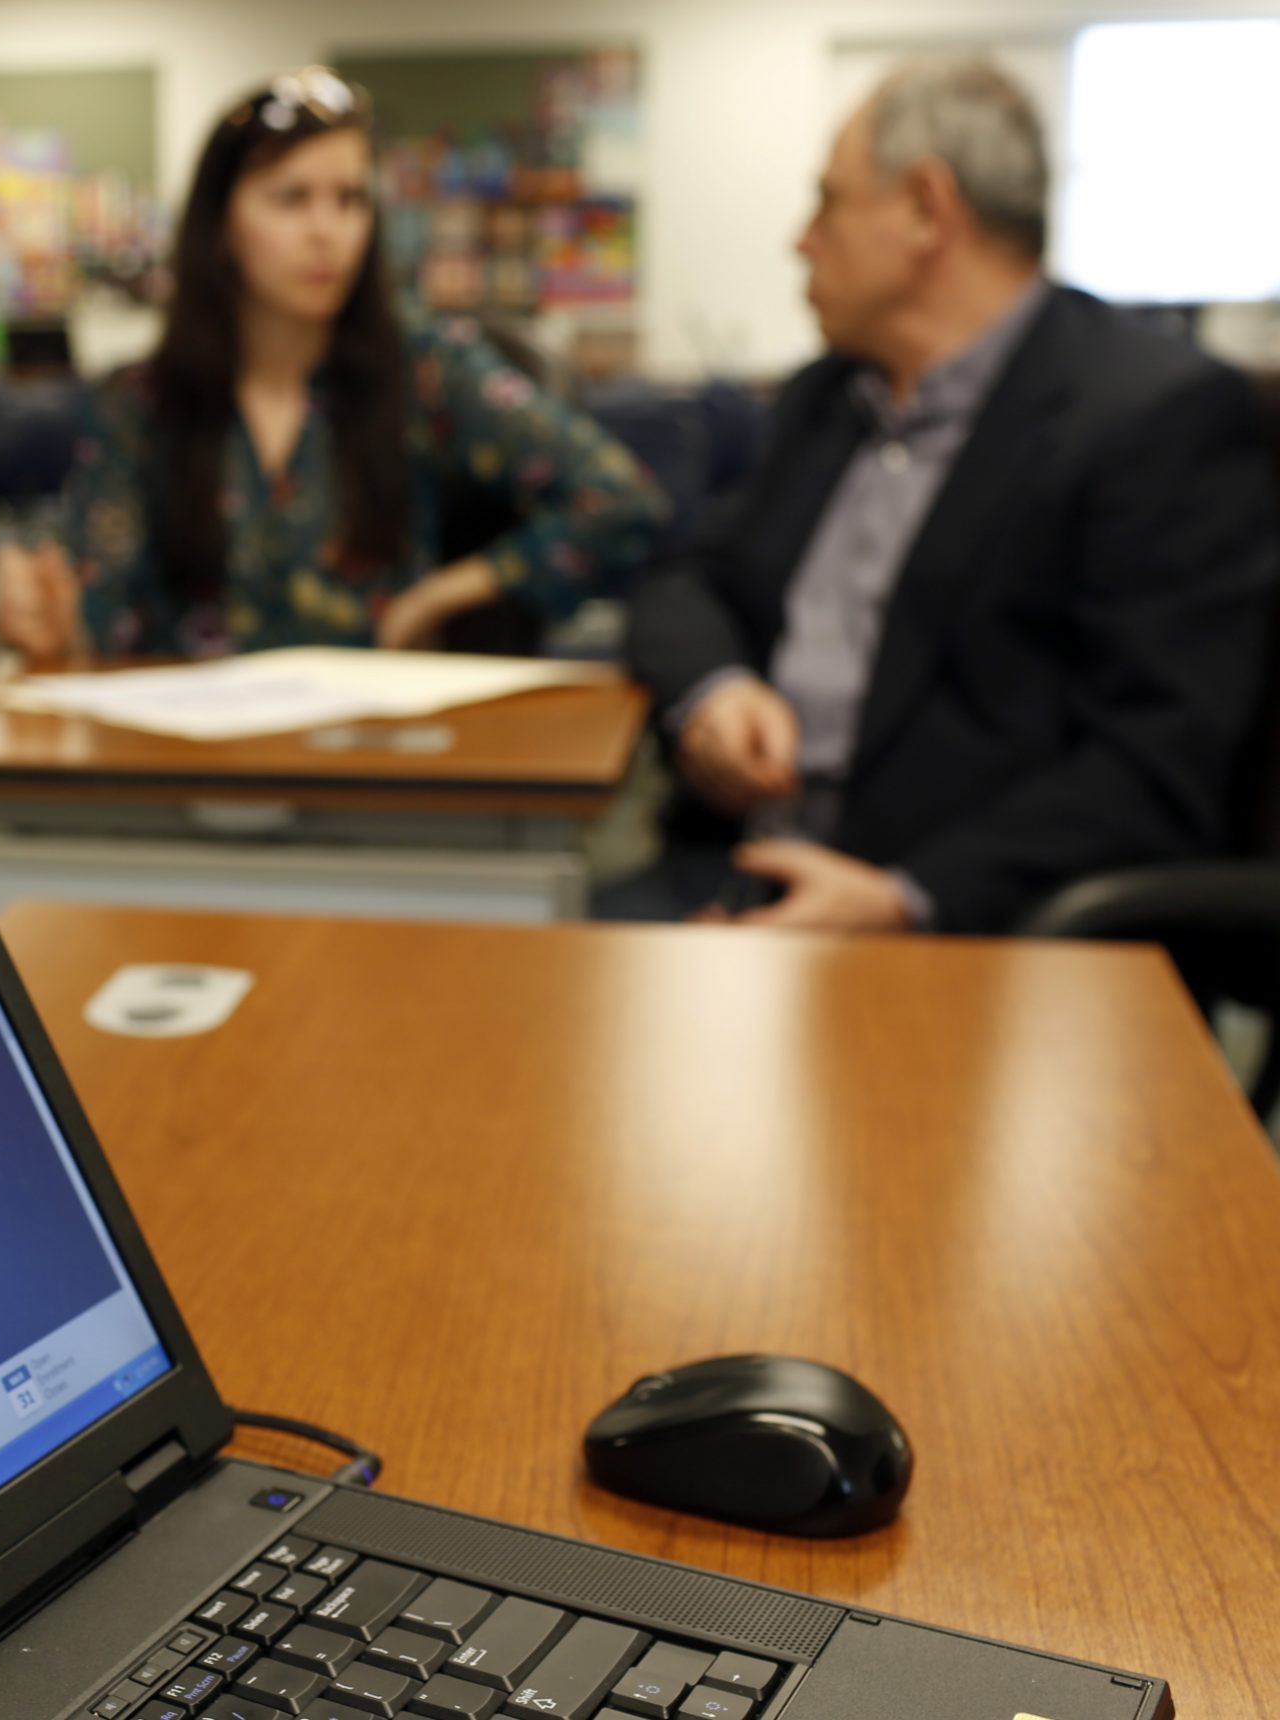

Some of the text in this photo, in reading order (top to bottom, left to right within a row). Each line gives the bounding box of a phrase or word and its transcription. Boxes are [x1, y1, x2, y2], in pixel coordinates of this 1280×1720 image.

[203, 1651, 225, 1666] F12
[226, 1644, 250, 1664] Pause
[453, 1646, 477, 1665] Enter
[166, 1684, 187, 1698] F11
[515, 1687, 539, 1706] Shift
